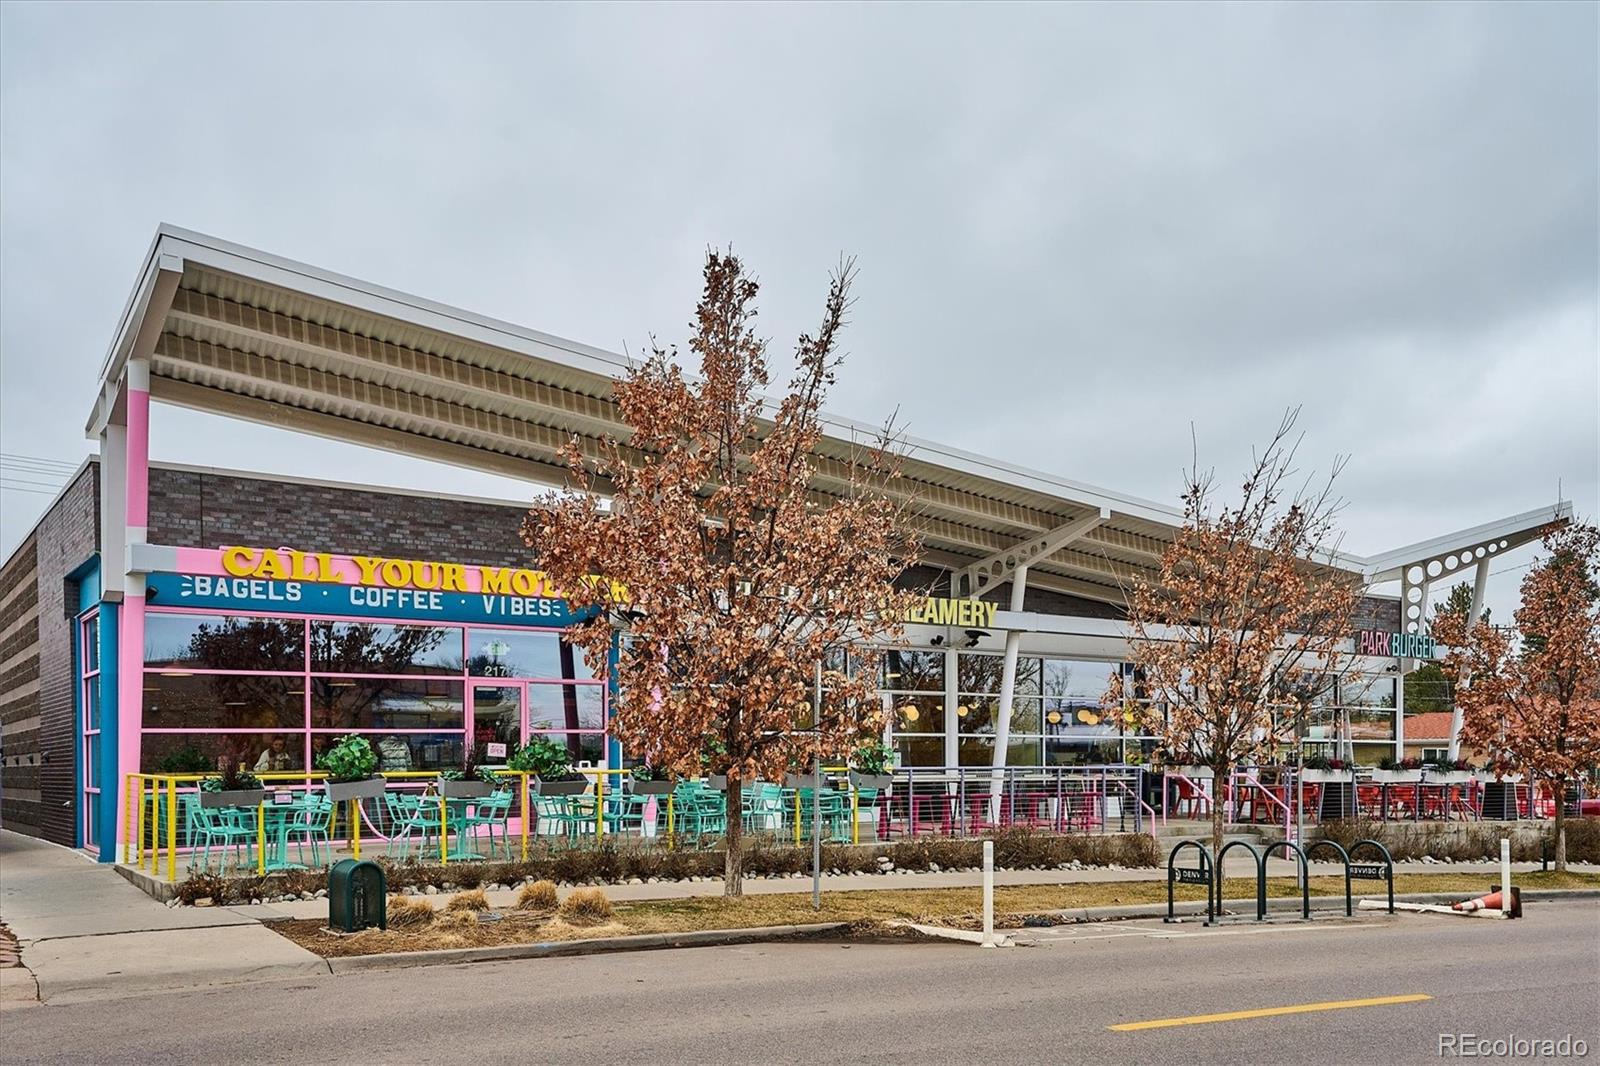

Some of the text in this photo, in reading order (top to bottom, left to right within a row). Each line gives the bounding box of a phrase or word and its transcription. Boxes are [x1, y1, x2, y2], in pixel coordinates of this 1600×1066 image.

[222, 546, 344, 583] CALL
[352, 555, 468, 593] YOUR
[194, 576, 551, 617] BAGELS COFFEE VIBES
[1360, 630, 1436, 659] PARK BURGER
[484, 665, 507, 677] 217
[1182, 870, 1209, 879] DENVR
